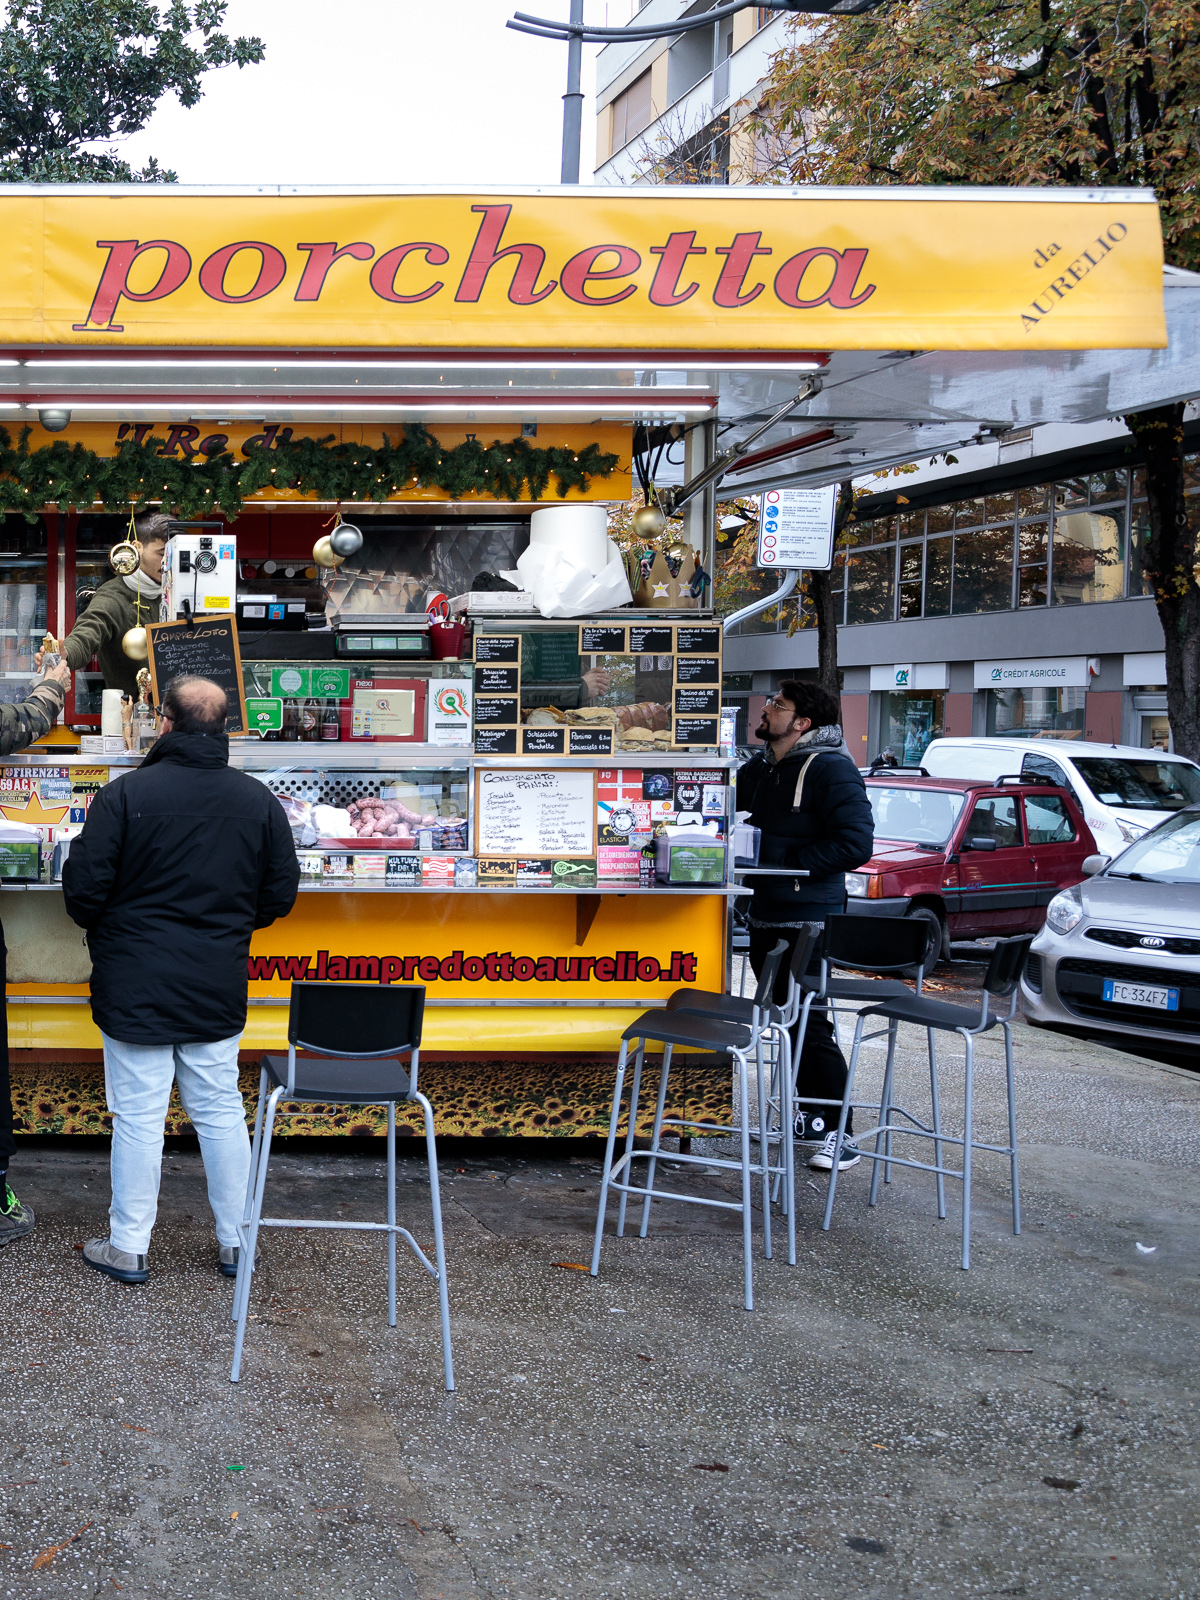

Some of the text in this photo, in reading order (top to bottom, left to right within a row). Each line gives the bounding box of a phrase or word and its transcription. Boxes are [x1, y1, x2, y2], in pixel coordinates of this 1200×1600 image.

[1033, 242, 1062, 269] da
[73, 203, 877, 332] porchetta
[1020, 222, 1128, 334] AURELIO
[157, 424, 229, 457] Re
[1003, 669, 1029, 678] CRÉDIT
[1029, 668, 1066, 678] AGRICOLE
[571, 731, 592, 741] Panino
[13, 767, 61, 778] FIRENZE
[479, 861, 516, 872] SUPPORT
[1142, 938, 1160, 946] KIA
[247, 949, 698, 985] ww.lampredottoaurelio.it
